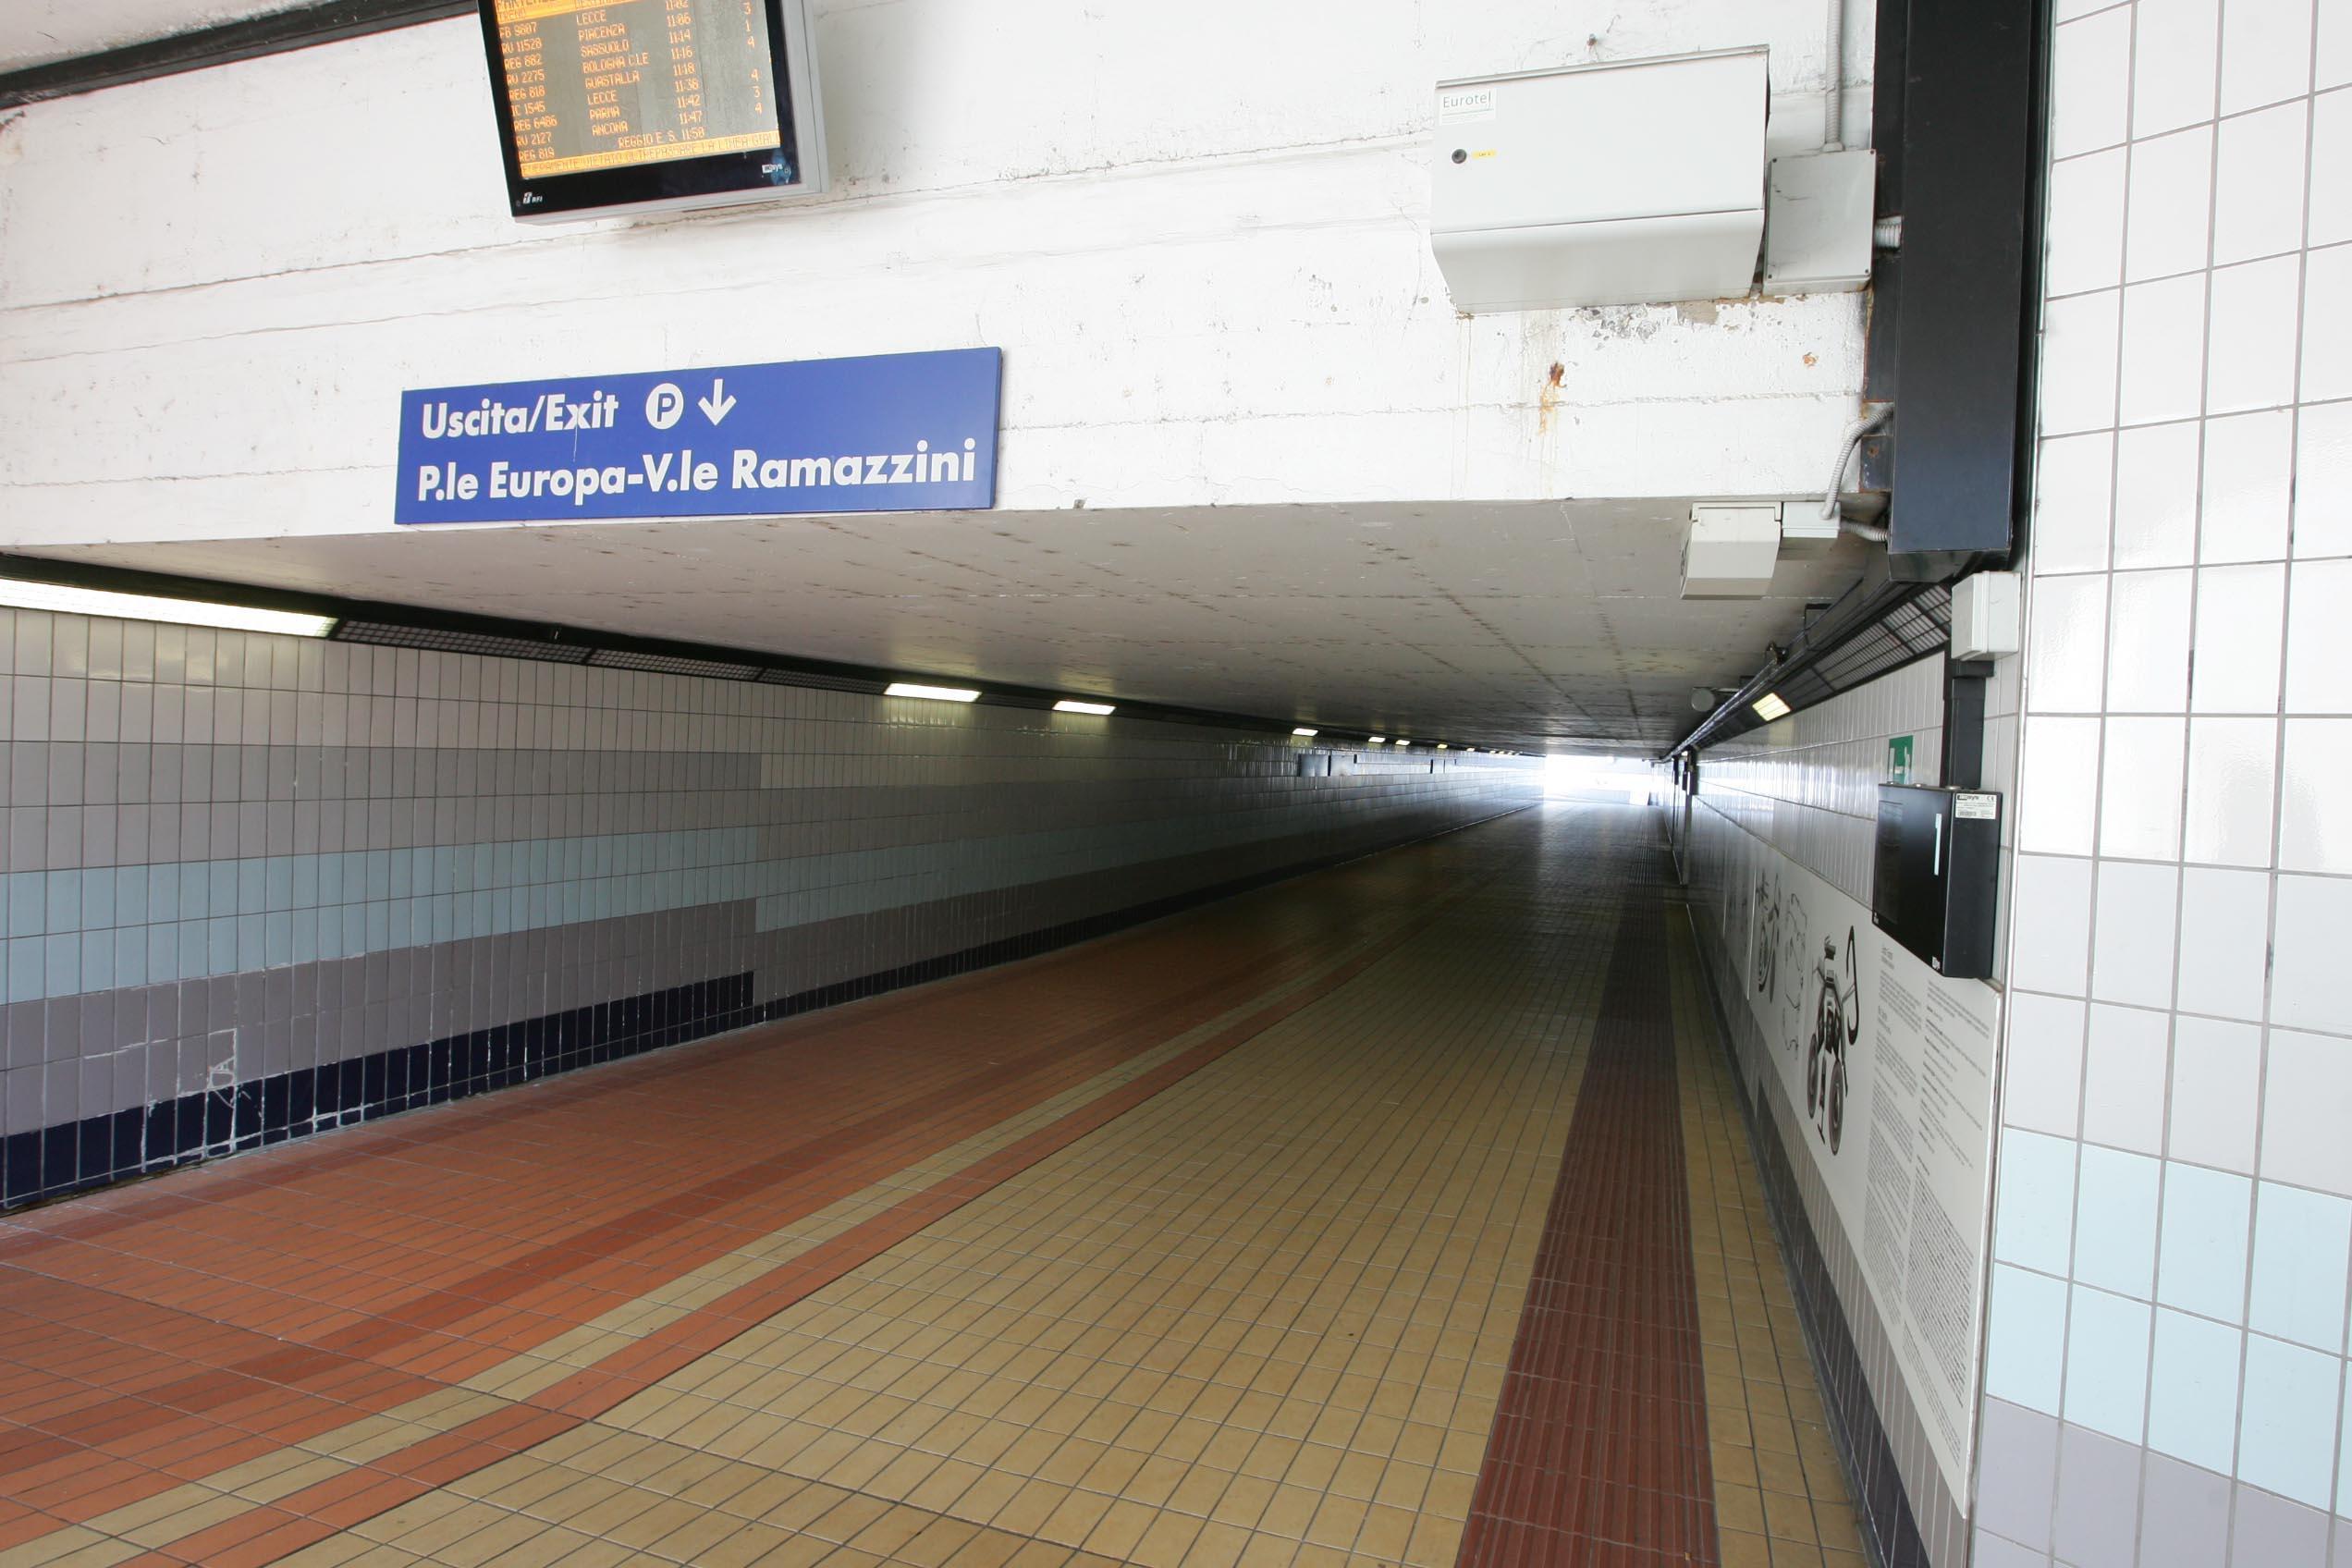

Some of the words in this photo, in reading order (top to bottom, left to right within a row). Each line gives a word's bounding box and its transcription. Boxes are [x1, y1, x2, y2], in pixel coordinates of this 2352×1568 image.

[499, 26, 511, 39] FB
[576, 10, 606, 26] LECCE
[517, 38, 543, 53] 11528
[578, 24, 625, 42] PIACENZA
[504, 58, 521, 71] REG
[582, 40, 629, 57] SASSUOLO
[669, 31, 692, 44] 11:14
[521, 69, 545, 83] 2275
[582, 56, 626, 75] BOLOGNA
[671, 46, 693, 60] 11:16
[747, 36, 755, 48] 4
[508, 89, 526, 102] REG
[585, 71, 640, 90] GUASTALLA
[673, 63, 696, 77] 11:18
[511, 104, 521, 117] IC
[524, 101, 545, 116] 1545
[587, 91, 619, 106] LECCE
[675, 80, 699, 93] 11:38
[751, 68, 759, 81] 4
[1442, 90, 1491, 108] Eurotel
[514, 119, 532, 132] REG
[589, 106, 620, 121] PARMA
[677, 96, 702, 109] 11:42
[531, 131, 552, 145] 2127
[592, 121, 629, 137] ANCONA
[680, 111, 704, 125] 11:47
[754, 104, 763, 115] 4
[519, 150, 535, 163] REG
[619, 131, 654, 149] REGGIO
[656, 131, 663, 143] E
[423, 392, 619, 439] Uscita/Exit
[418, 464, 479, 502] P.le
[490, 448, 718, 506] Europa-V.le
[732, 439, 976, 490] Ramazzini
